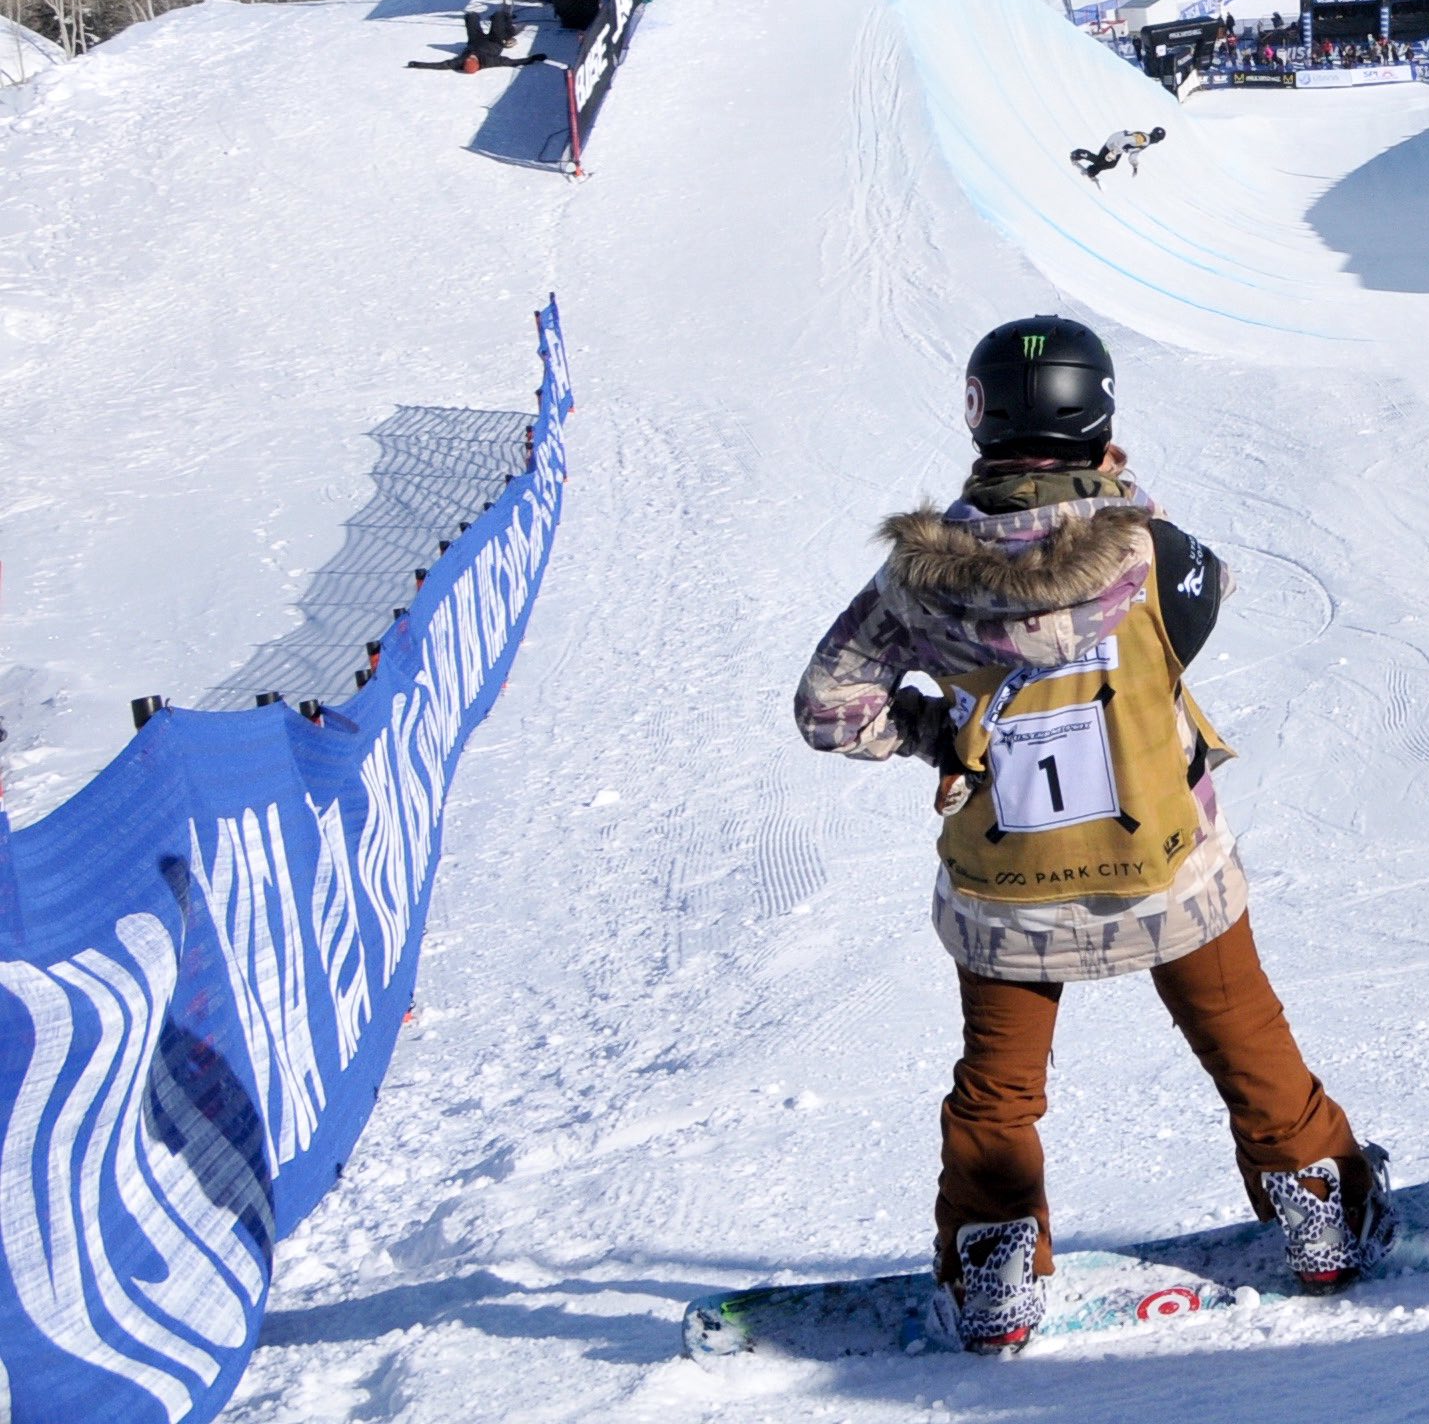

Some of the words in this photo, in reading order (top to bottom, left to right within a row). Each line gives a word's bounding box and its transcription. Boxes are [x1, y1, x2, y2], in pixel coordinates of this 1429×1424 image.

[1038, 754, 1064, 812] 1
[1036, 867, 1089, 884] PARK
[1098, 861, 1145, 877] CITY
